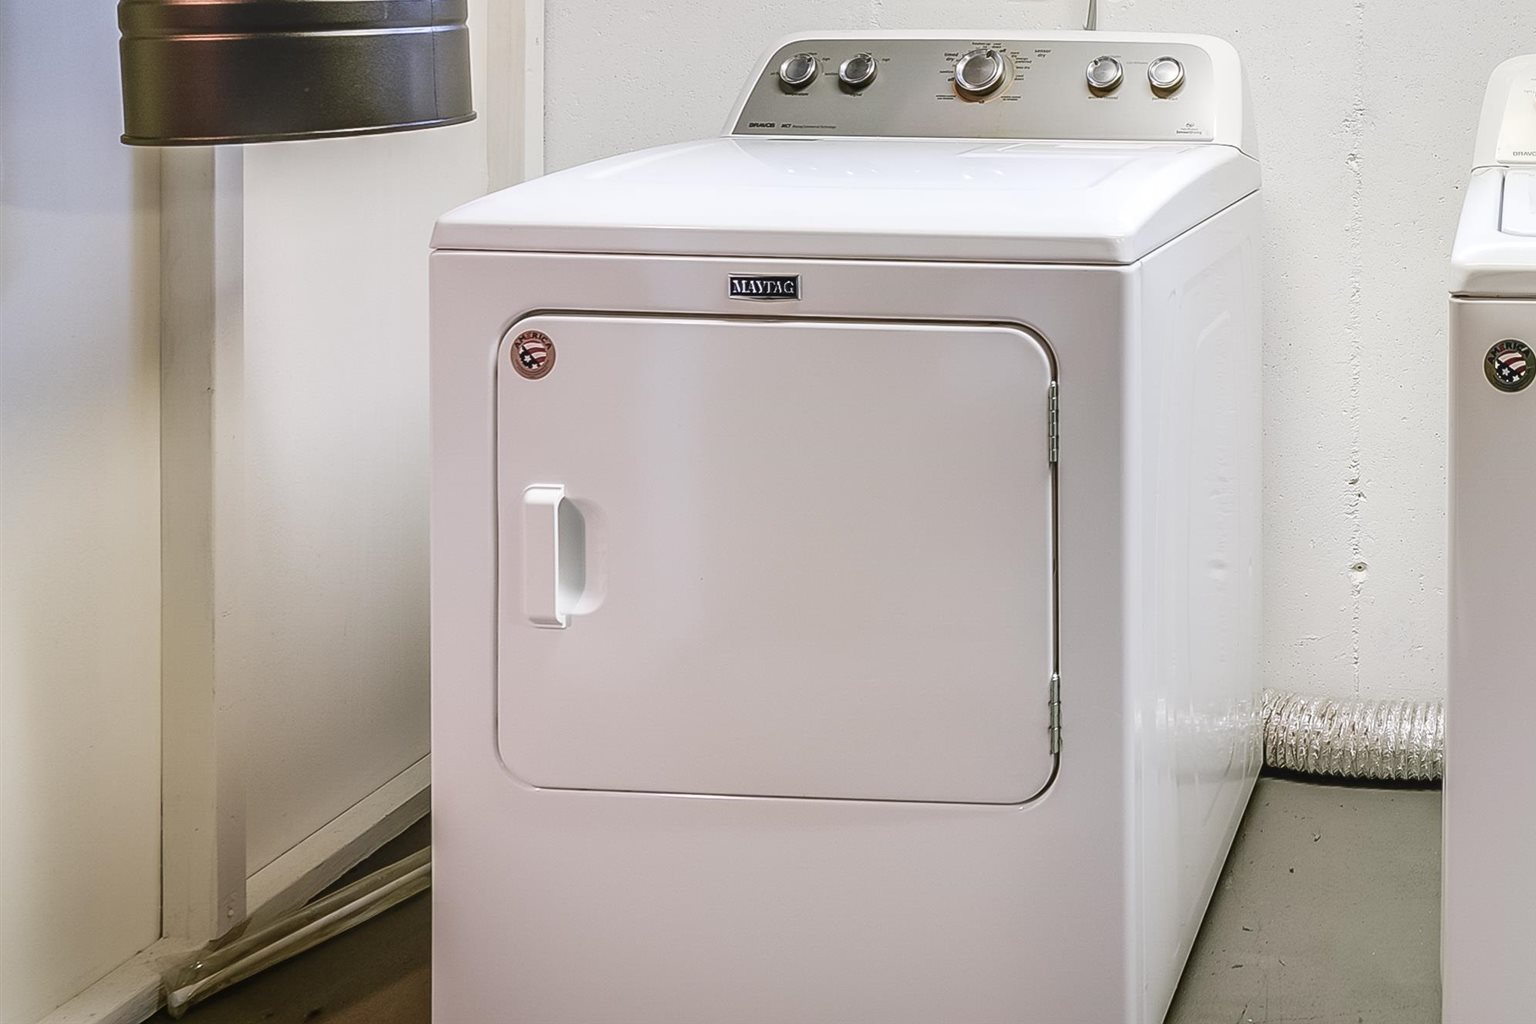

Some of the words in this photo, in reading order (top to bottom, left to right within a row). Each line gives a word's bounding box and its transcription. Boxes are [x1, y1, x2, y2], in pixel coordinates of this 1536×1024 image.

[732, 279, 794, 294] MAYTAG
[514, 332, 552, 350] AMERICA
[1488, 342, 1530, 365] AMERICA
